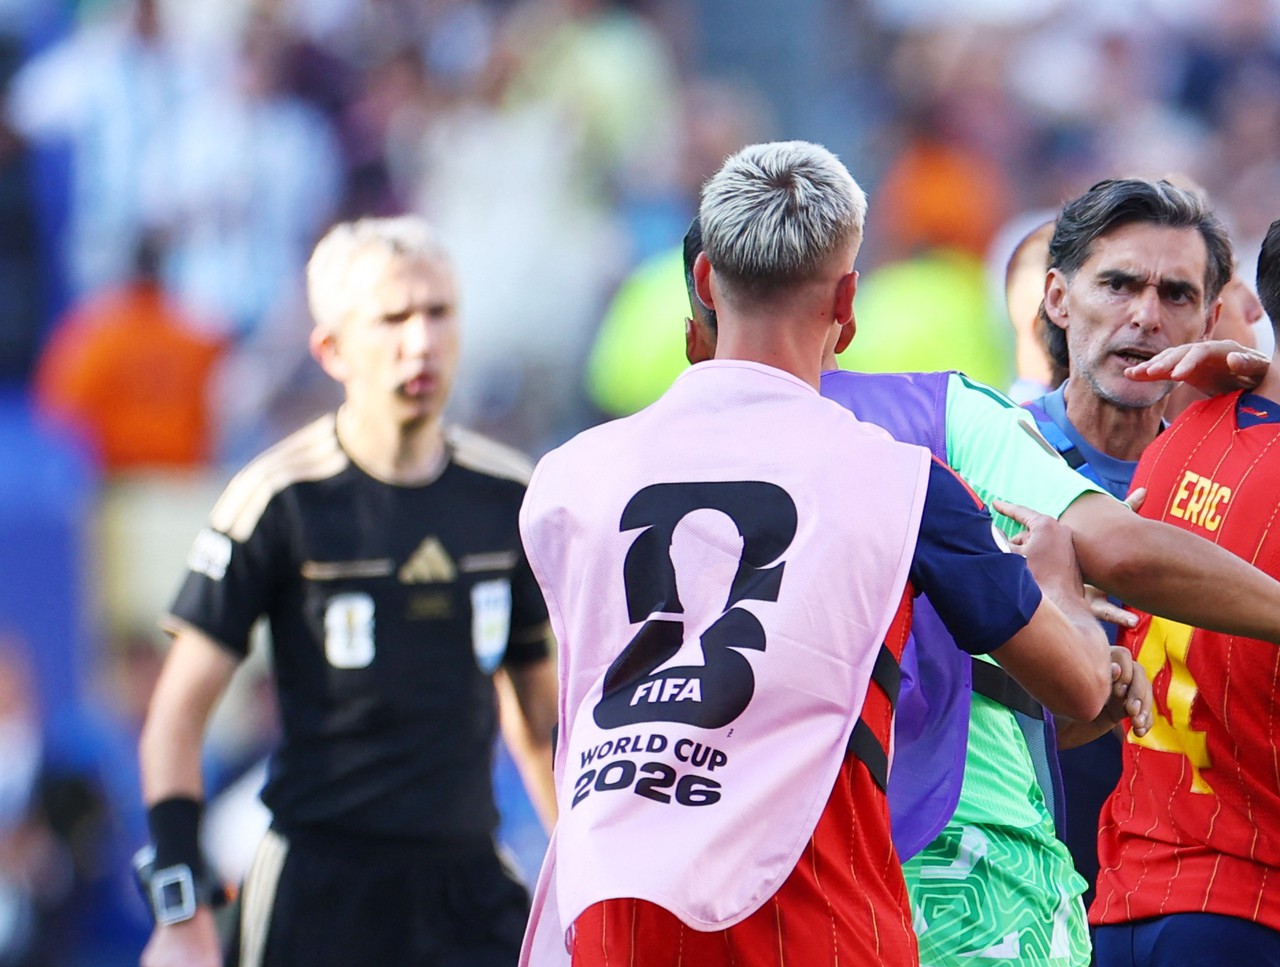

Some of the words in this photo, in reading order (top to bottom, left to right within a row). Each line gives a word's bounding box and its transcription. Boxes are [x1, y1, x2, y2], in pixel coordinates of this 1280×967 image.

[1169, 470, 1232, 532] ERIC
[629, 677, 702, 707] FIFA
[1127, 615, 1216, 795] 4
[580, 734, 669, 770] WORLD
[674, 738, 728, 772] CUP
[571, 759, 722, 810] 2026
